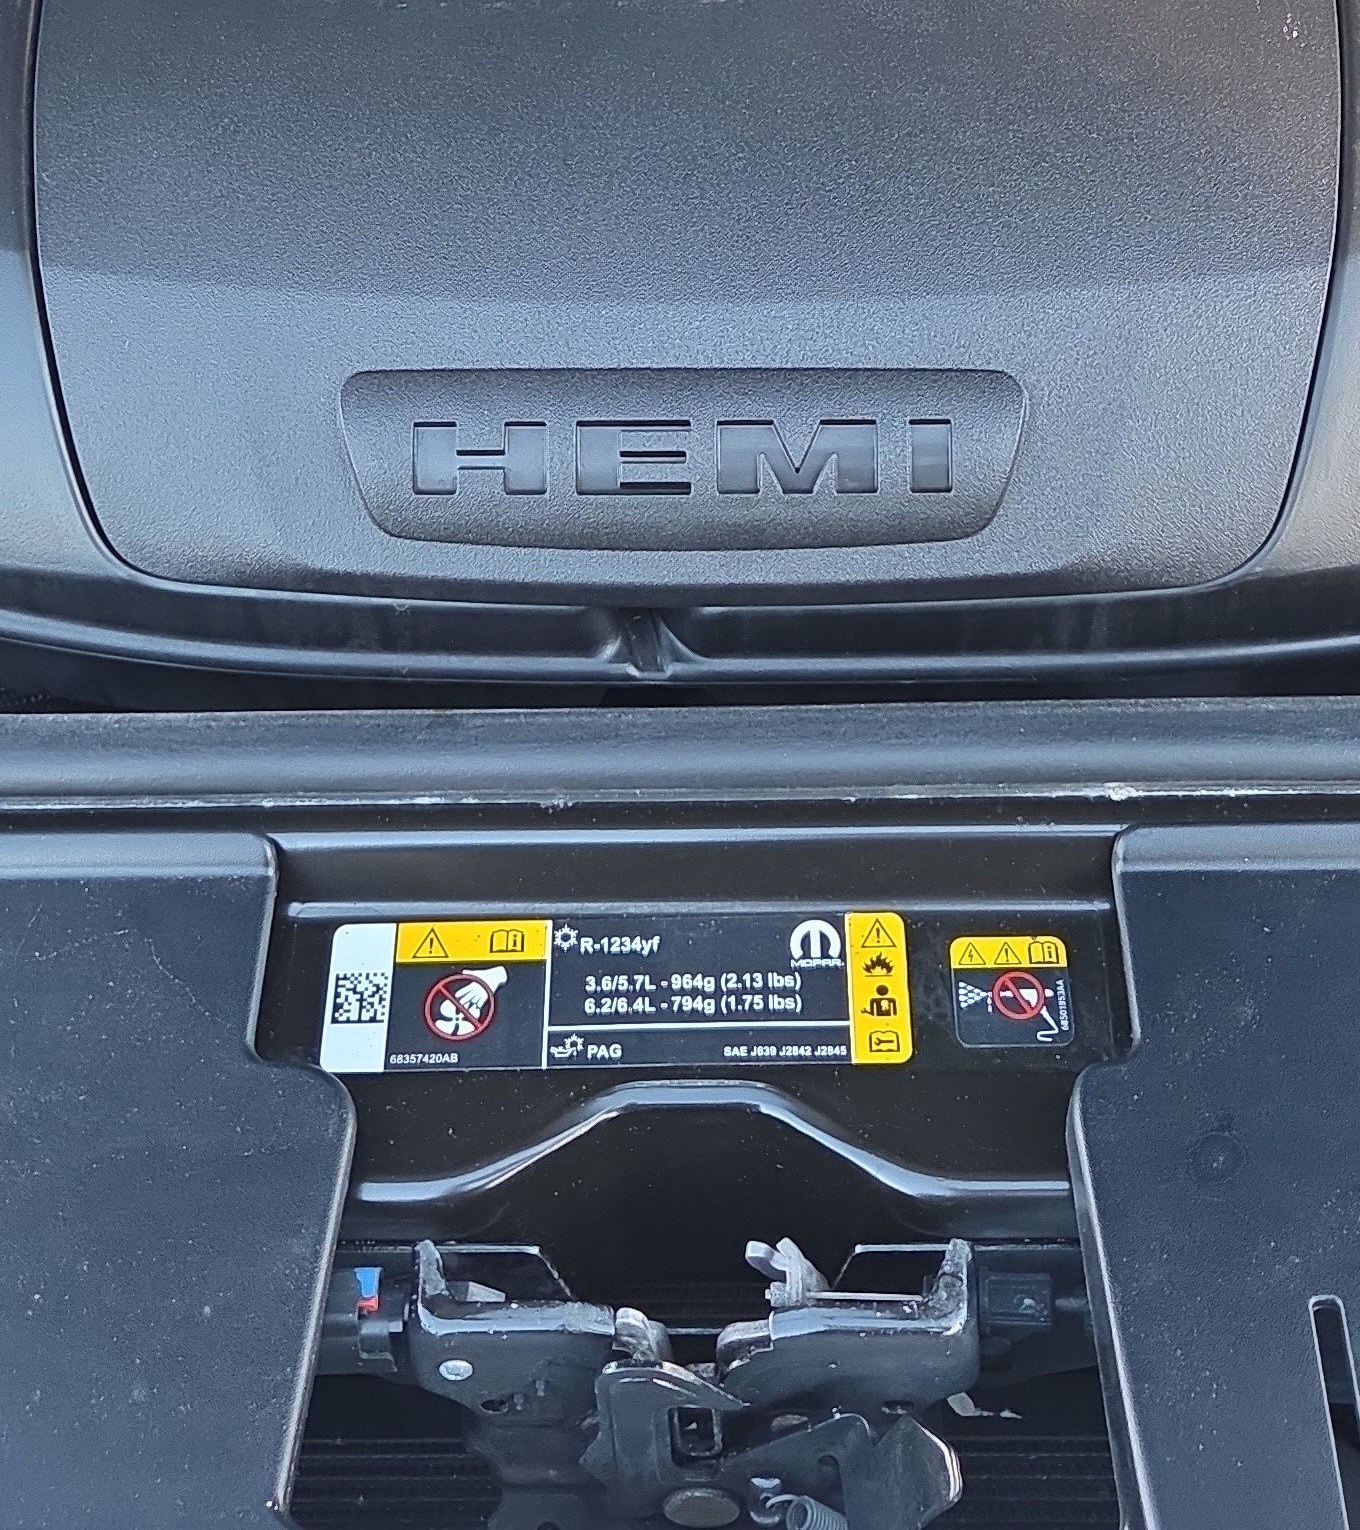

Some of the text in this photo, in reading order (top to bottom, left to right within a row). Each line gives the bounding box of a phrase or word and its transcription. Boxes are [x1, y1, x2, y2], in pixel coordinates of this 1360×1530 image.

[412, 418, 953, 496] HEMI
[580, 935, 661, 958] R-1234yf
[584, 974, 657, 993] 3.6/5.7L
[670, 973, 716, 993] 964g
[720, 971, 764, 992] (2.13
[767, 971, 803, 991] lbs)
[584, 996, 657, 1015] 6.2/6.4L
[670, 995, 716, 1017] 794g
[720, 993, 764, 1016] (1.75
[767, 993, 803, 1015] lbs)
[389, 1052, 459, 1065] 68357420AB
[587, 1043, 623, 1059] PAG
[723, 1045, 749, 1057] SAE
[750, 1045, 777, 1057] J639
